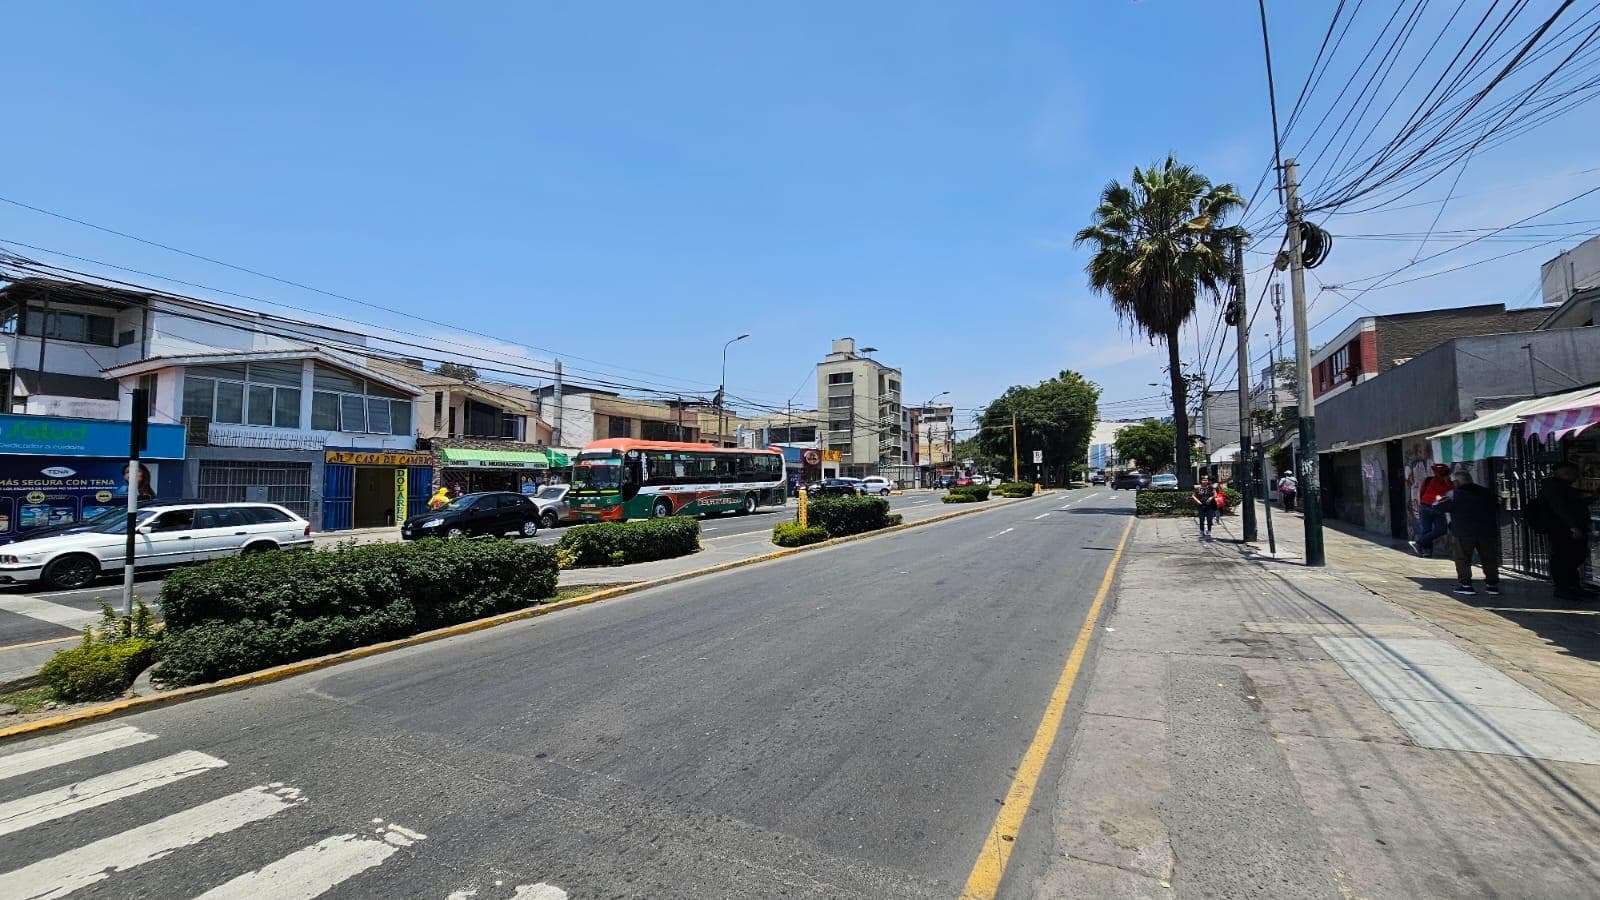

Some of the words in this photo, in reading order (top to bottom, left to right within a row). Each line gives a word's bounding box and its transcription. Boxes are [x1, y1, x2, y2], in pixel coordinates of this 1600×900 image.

[355, 455, 380, 463] CASA
[384, 455, 397, 463] DE
[399, 455, 433, 465] CAMBIO
[396, 469, 405, 522] DOLARES
